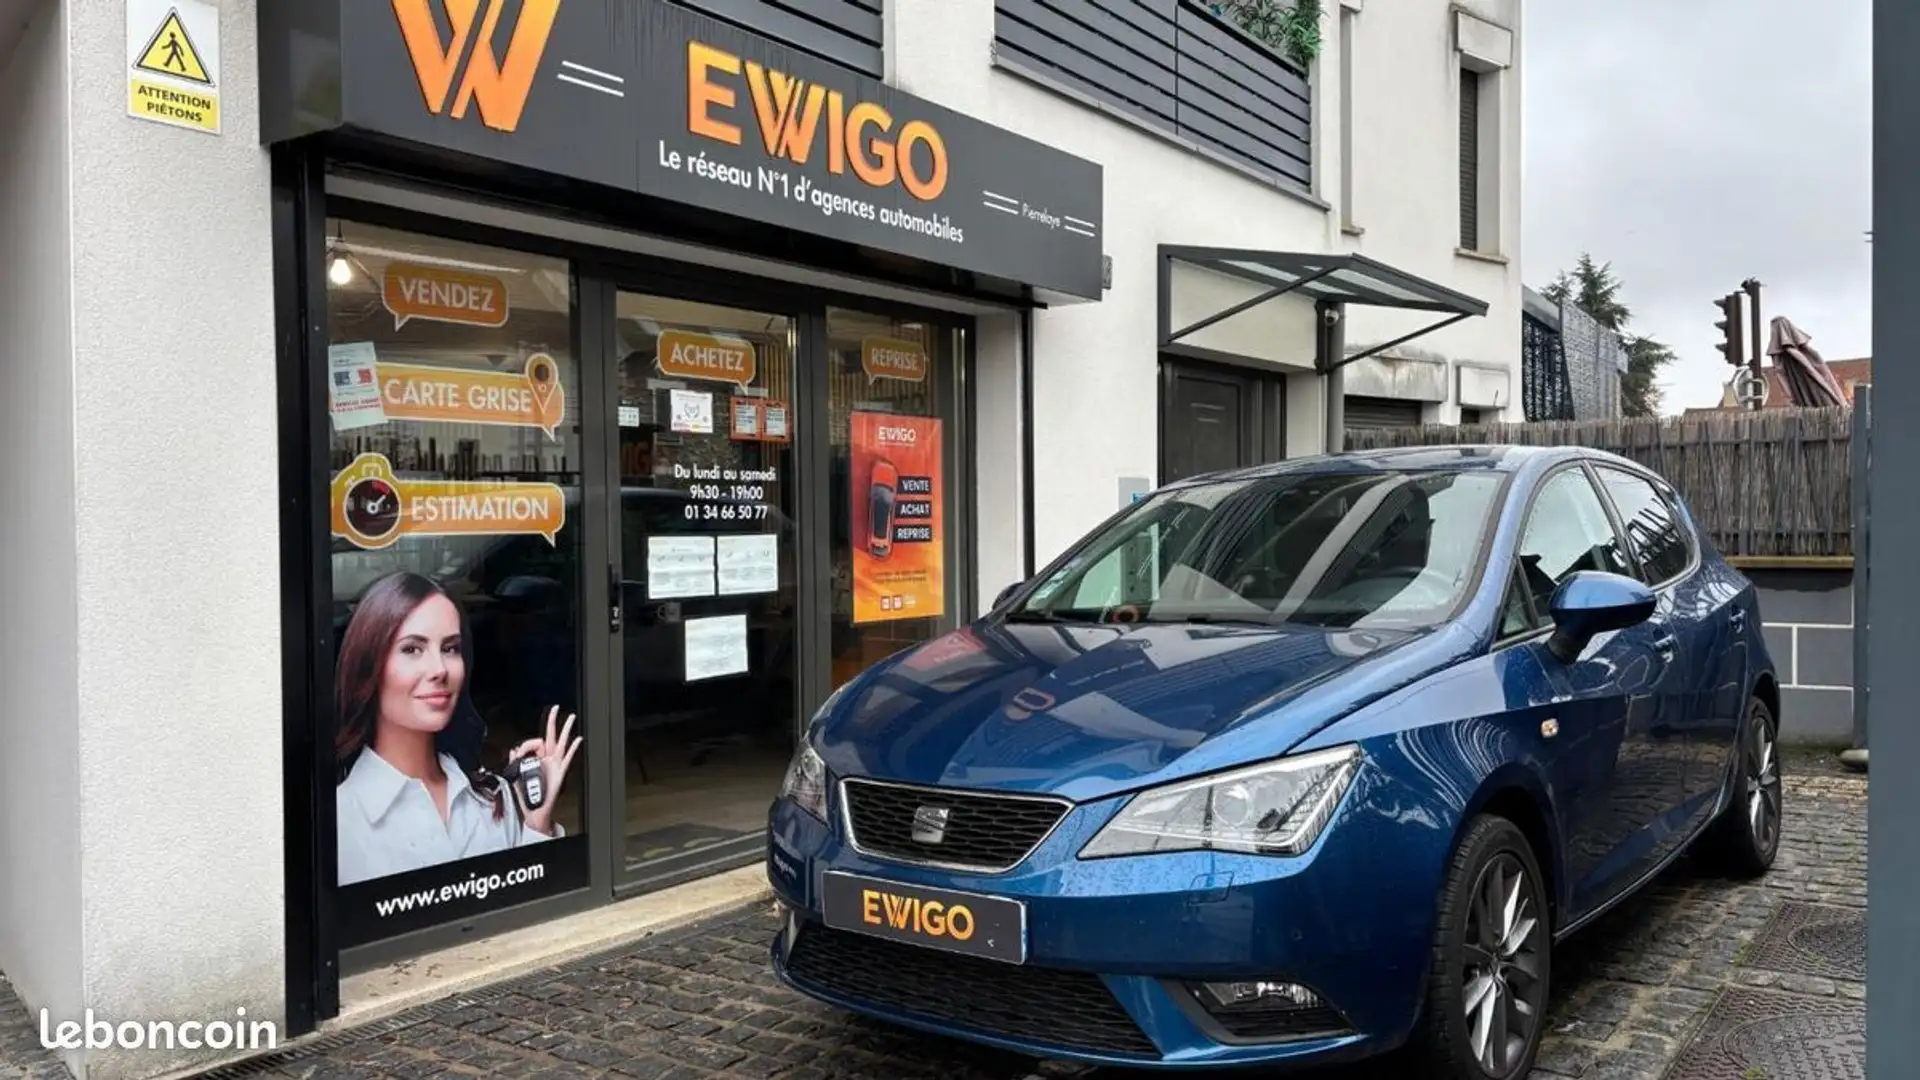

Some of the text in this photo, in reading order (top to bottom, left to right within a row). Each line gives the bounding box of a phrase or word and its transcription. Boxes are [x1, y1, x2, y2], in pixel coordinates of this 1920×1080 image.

[137, 84, 211, 110] ATTENTION
[146, 102, 203, 122] PIÉTONS
[686, 40, 949, 202] EWIGO
[658, 139, 682, 170] Le
[687, 151, 752, 189] réseau
[794, 175, 876, 216] d'agences
[879, 207, 964, 243] automobiles
[397, 276, 496, 314] VENDEZ
[669, 343, 746, 372] ACHETEZ
[870, 347, 920, 372] REPRISE
[383, 378, 461, 410] CARTE
[467, 385, 533, 414] GRISE
[878, 425, 917, 442] EWIGO
[674, 462, 777, 481] Du lundi au samedi
[689, 483, 720, 499] 9h30
[730, 484, 764, 500] 19h00
[901, 479, 931, 493] VENTE
[410, 497, 549, 522] ESTIMATION
[684, 504, 769, 519] 01 34 66 50 77
[899, 503, 931, 515] ACHAT
[896, 527, 931, 540] REPRISE
[375, 863, 545, 917] www.ewigo.com
[861, 888, 975, 941] EWIGO
